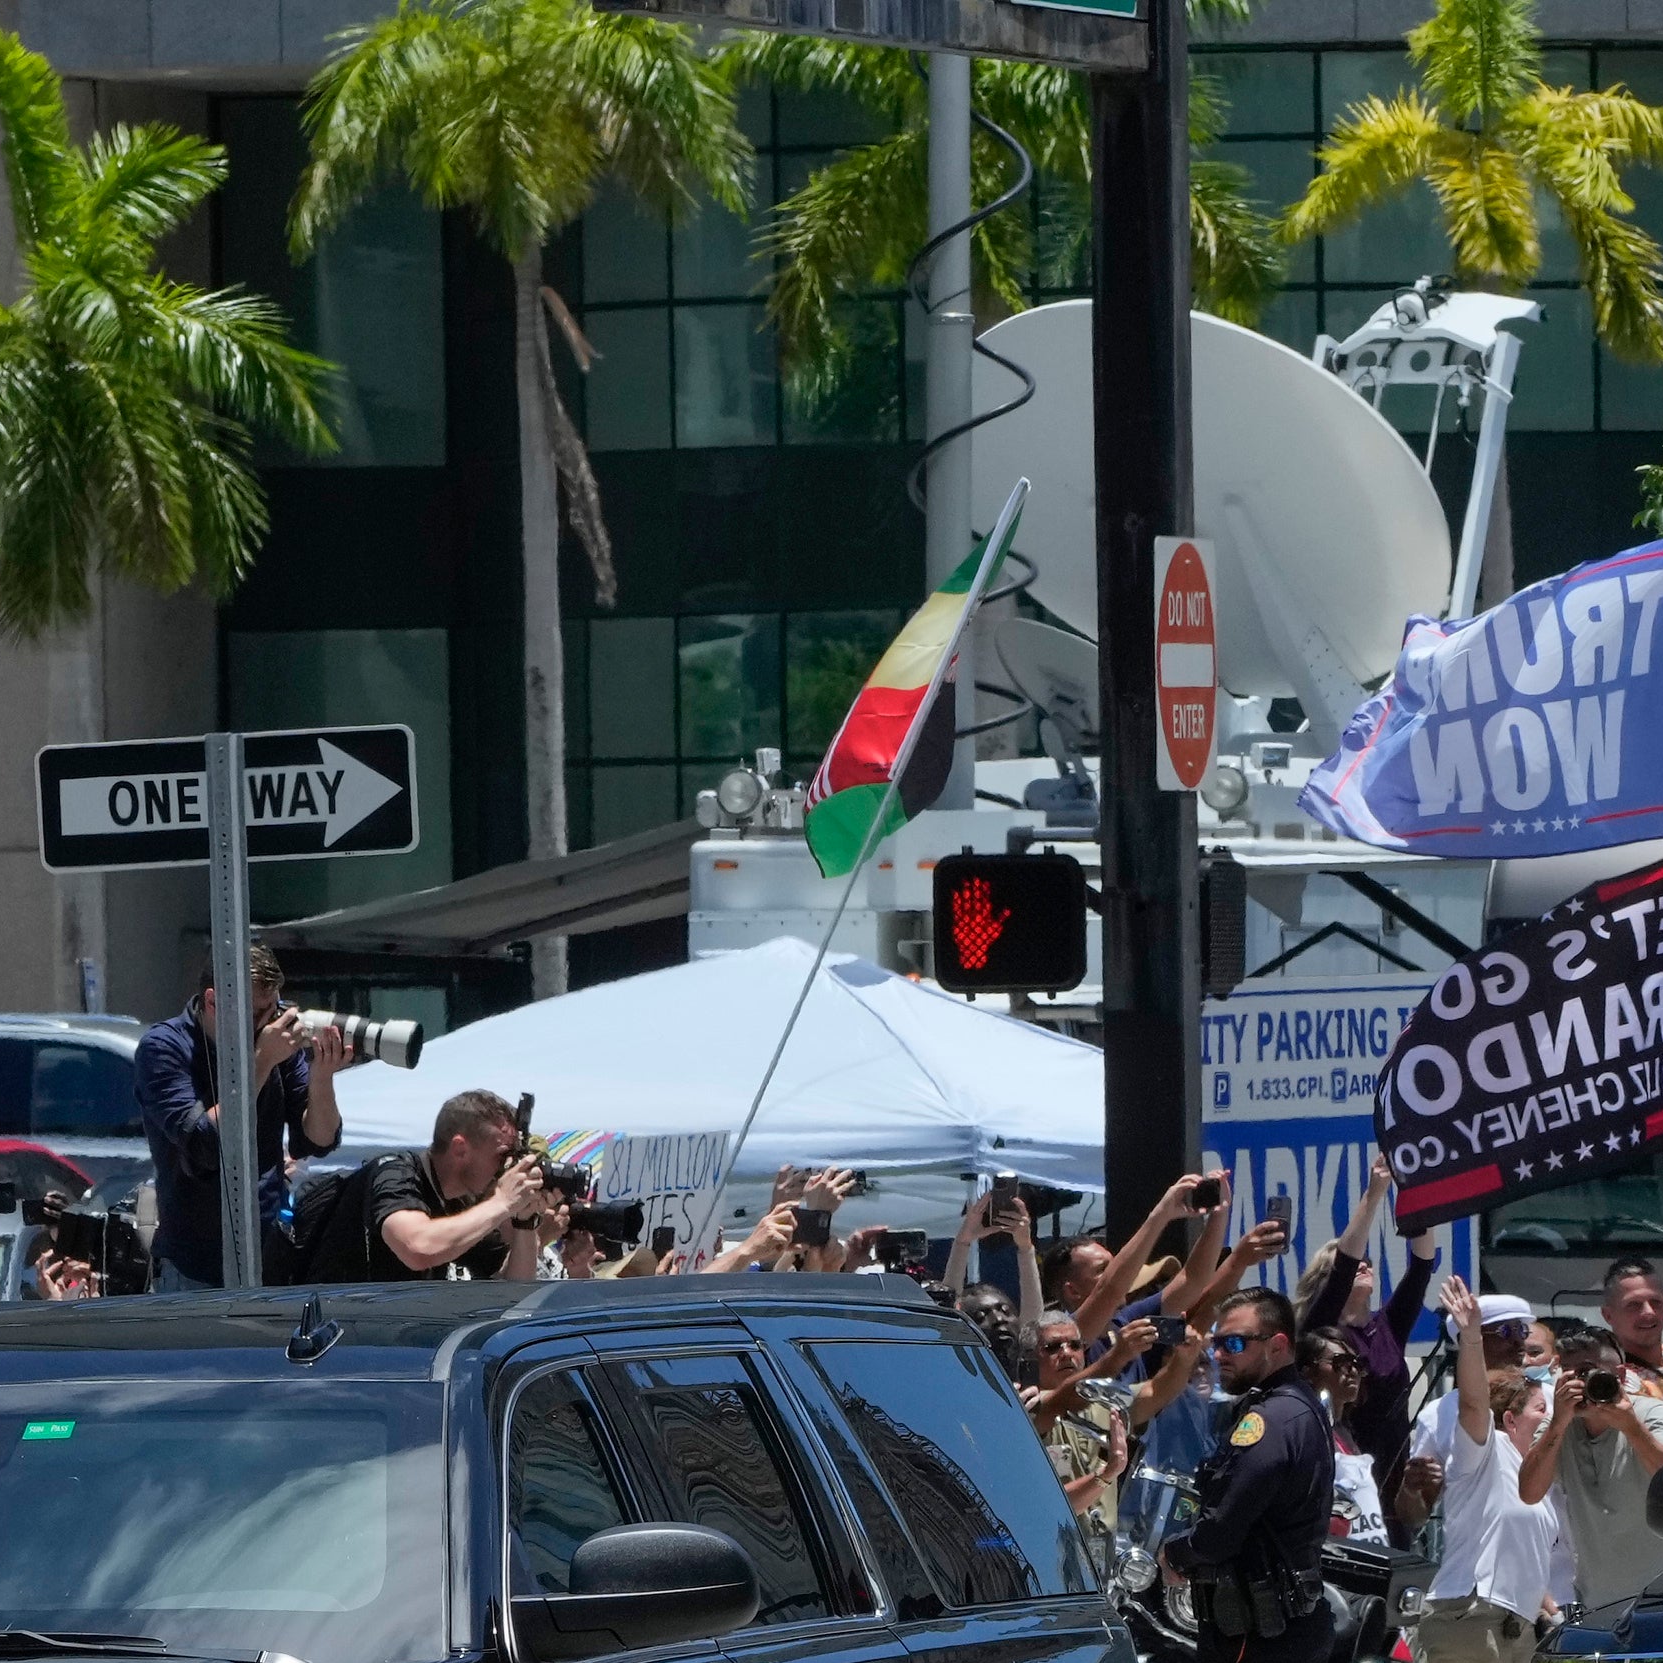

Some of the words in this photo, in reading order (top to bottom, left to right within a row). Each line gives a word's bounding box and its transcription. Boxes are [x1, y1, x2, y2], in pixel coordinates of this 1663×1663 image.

[1168, 591, 1182, 626] DO
[1187, 592, 1206, 626] NOT
[1172, 704, 1206, 739] ENTER
[108, 778, 201, 826] ONE
[248, 770, 345, 819] WAY
[1202, 1013, 1248, 1065] ITY
[1257, 1006, 1387, 1062] PARKING
[607, 1138, 632, 1198] 81
[637, 1133, 727, 1192] MILLION
